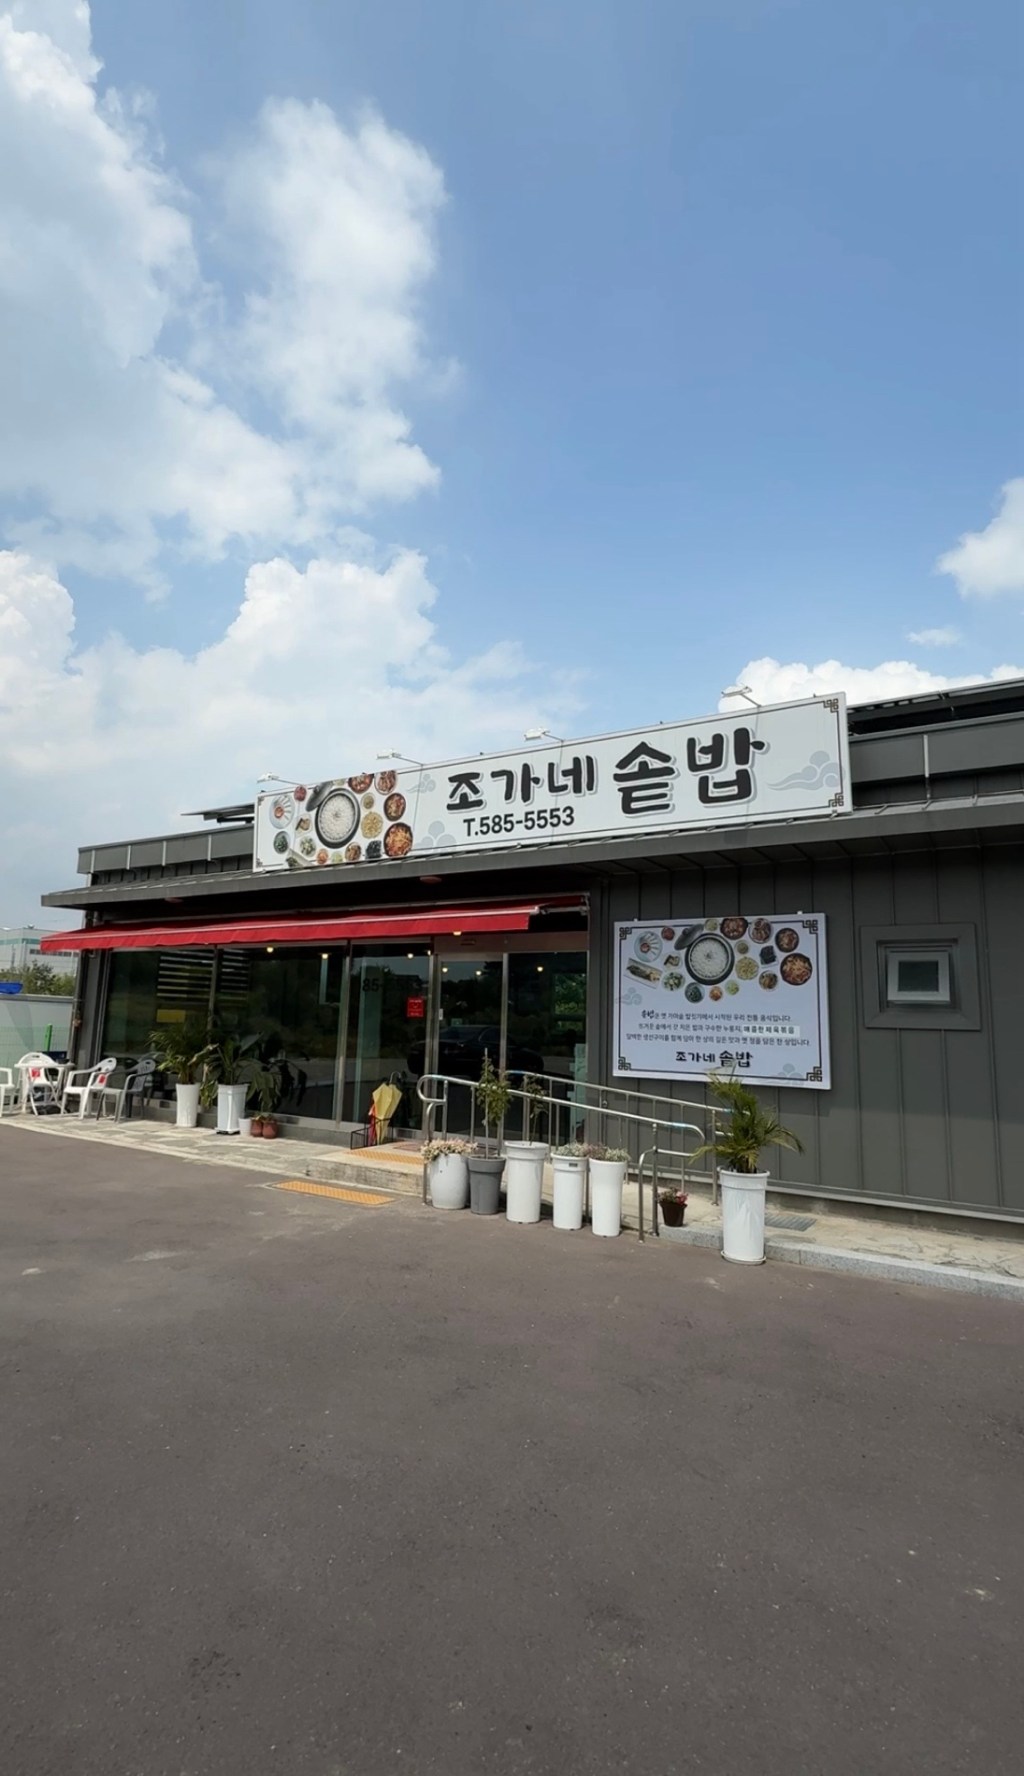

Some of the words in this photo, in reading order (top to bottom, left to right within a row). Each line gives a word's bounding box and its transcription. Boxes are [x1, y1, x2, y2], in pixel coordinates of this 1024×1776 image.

[445, 754, 596, 811] 조가네
[612, 727, 767, 815] 솥밥
[463, 806, 575, 837] T.585-5553
[675, 1051, 716, 1063] 조가네
[719, 1049, 754, 1068] 솥밥
